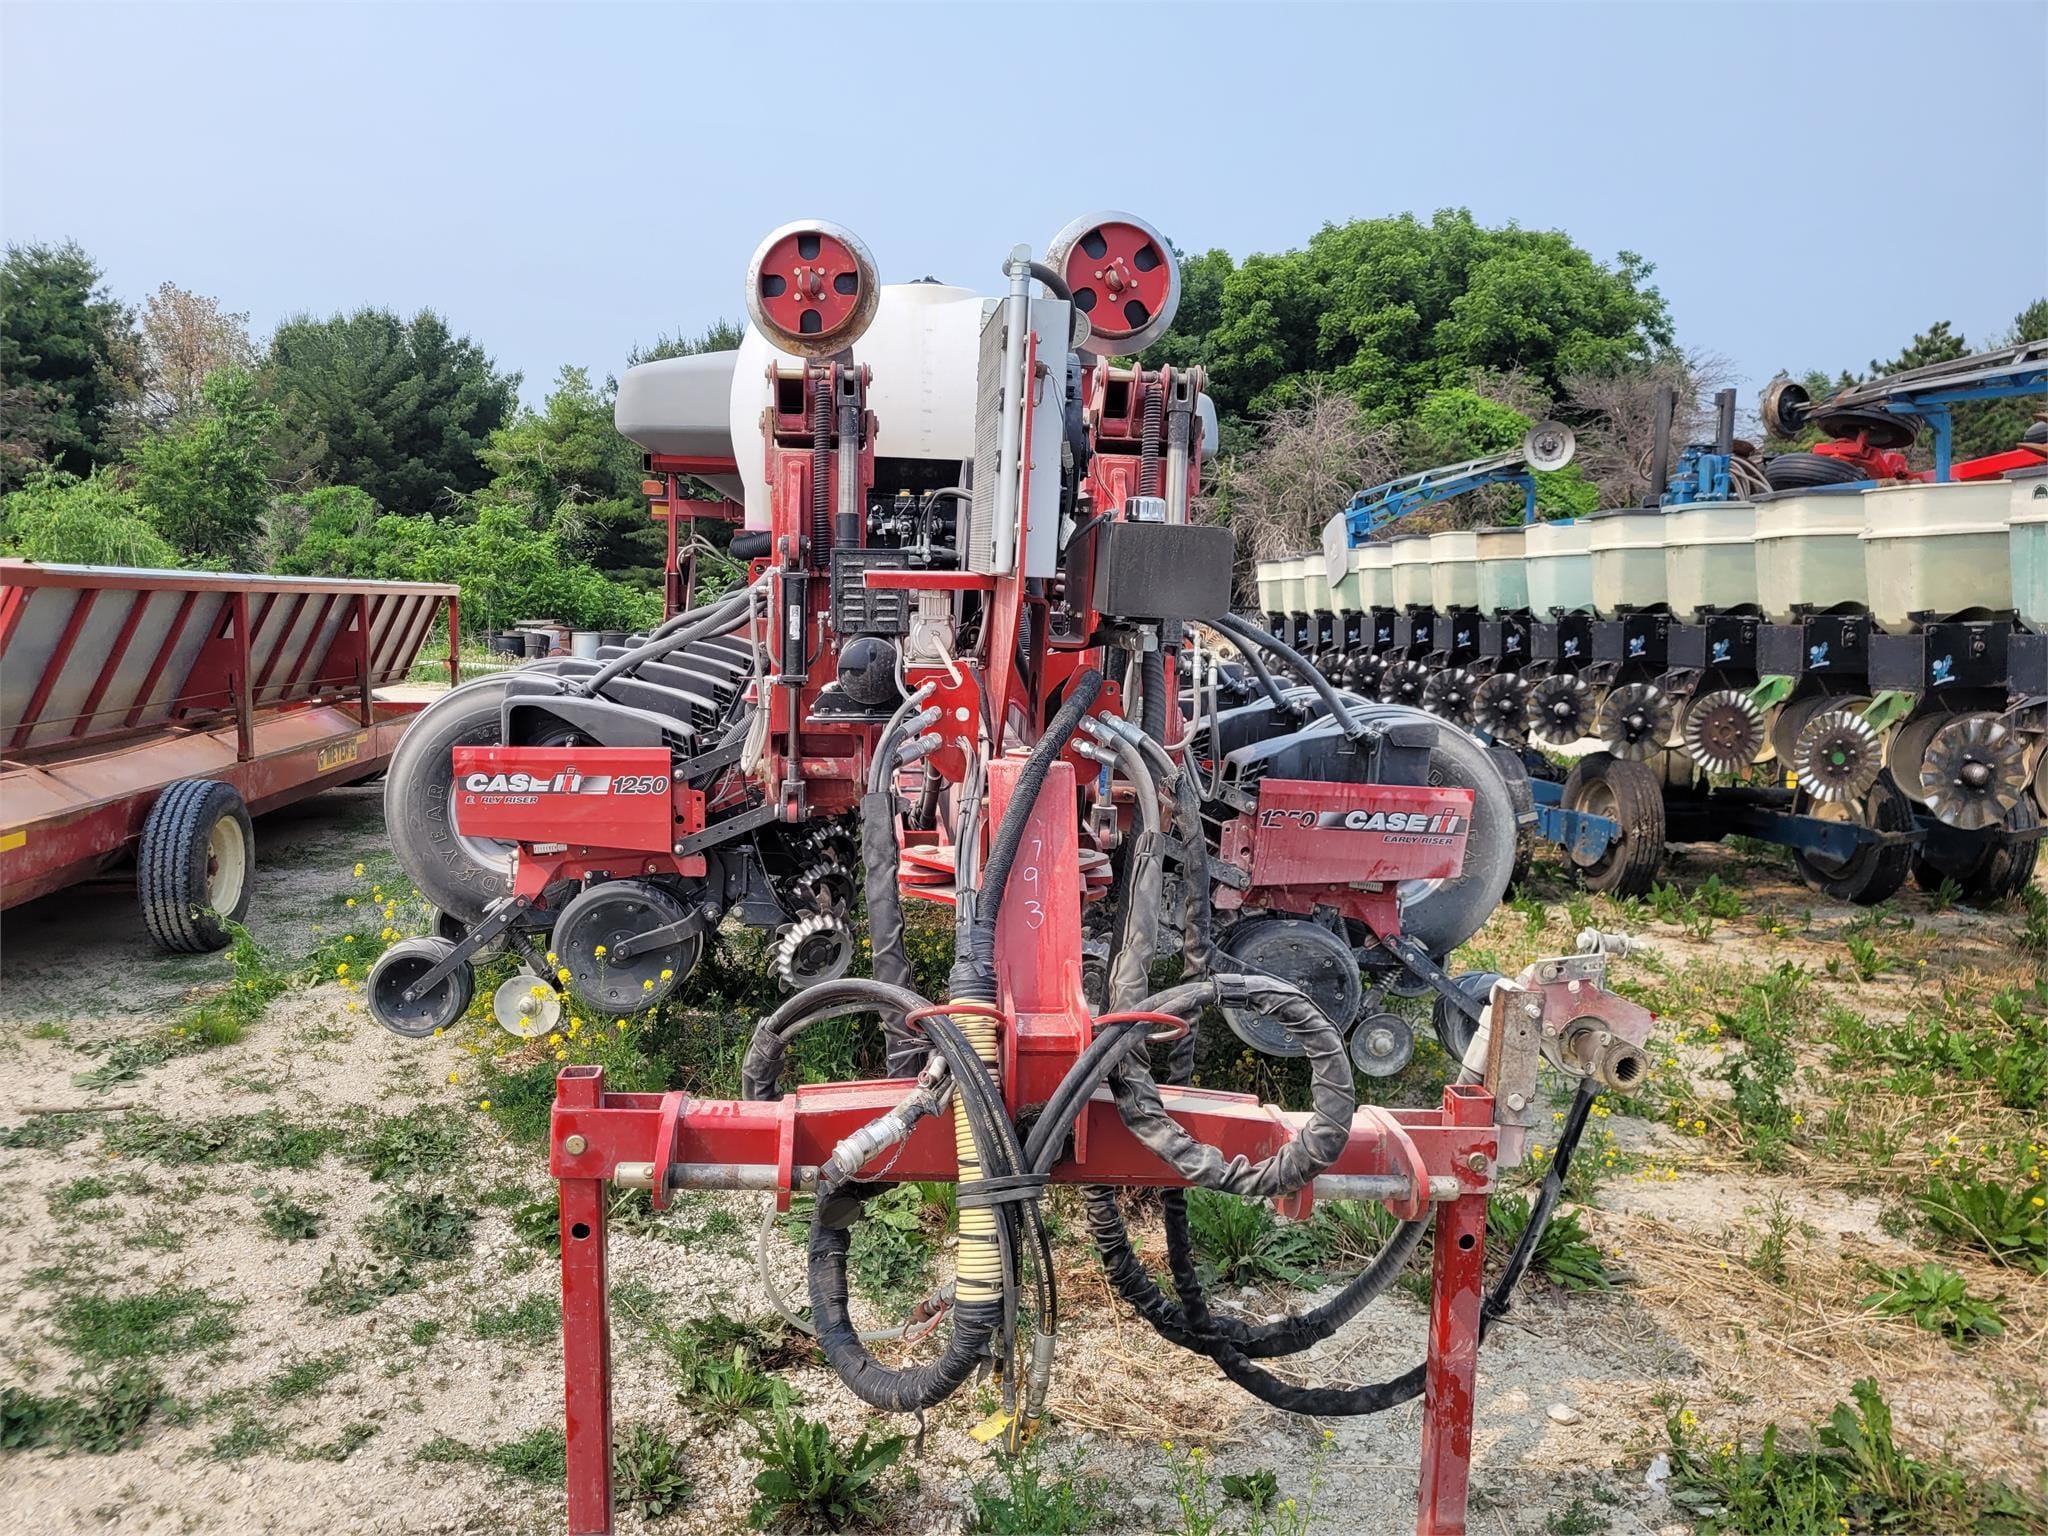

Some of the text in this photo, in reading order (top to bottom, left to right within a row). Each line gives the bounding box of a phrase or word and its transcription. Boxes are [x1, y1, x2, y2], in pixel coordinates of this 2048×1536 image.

[612, 775, 669, 795] 1250
[504, 795, 539, 804] RISER
[1344, 810, 1428, 833] CASE
[1383, 835, 1453, 845] EARLY RISER
